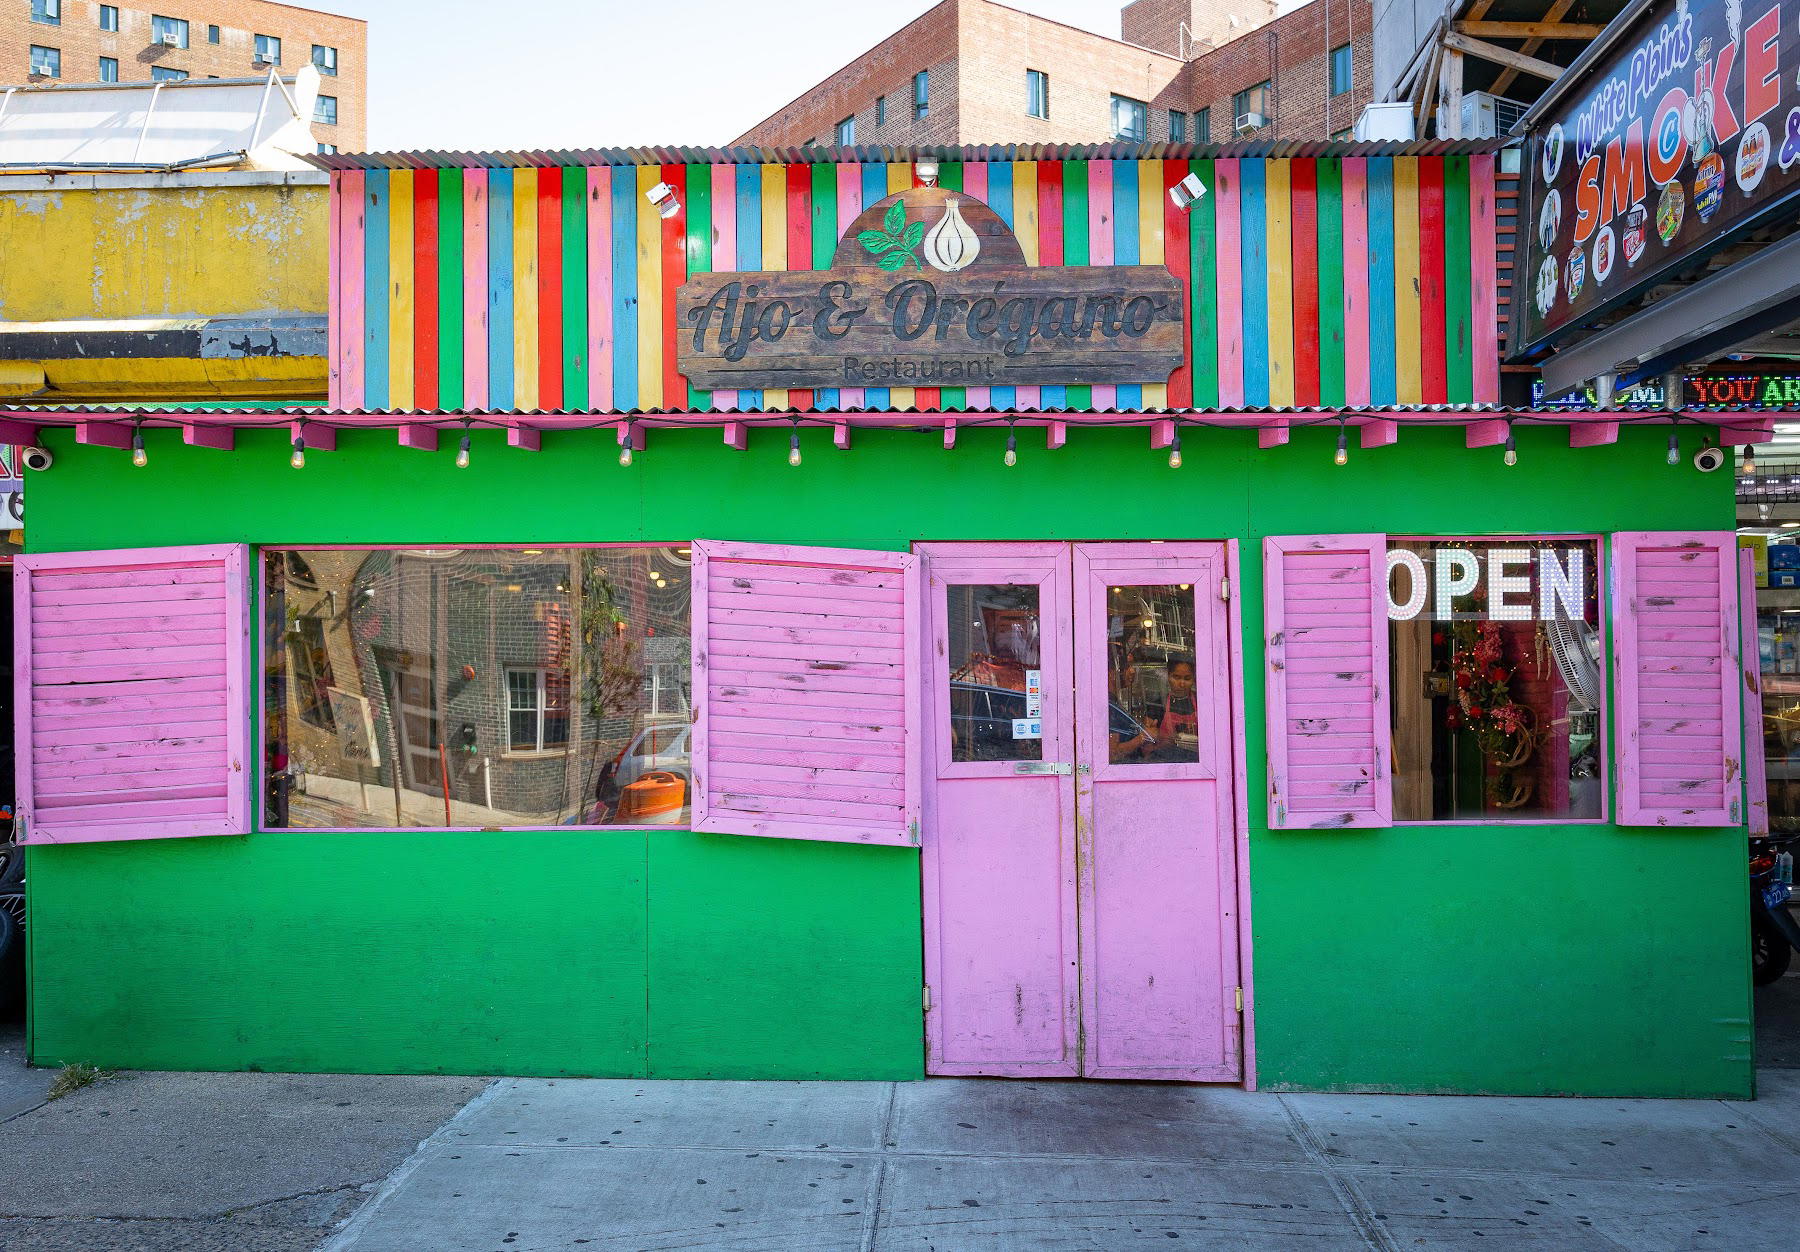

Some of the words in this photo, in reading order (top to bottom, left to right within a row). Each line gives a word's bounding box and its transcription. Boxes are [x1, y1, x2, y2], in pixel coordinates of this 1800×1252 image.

[1574, 3, 1780, 242] SMOKE
[1577, 77, 1626, 165] White
[688, 281, 803, 362] Ajo
[812, 280, 867, 341] &
[885, 279, 1167, 358] Orégano
[844, 356, 994, 380] Restaurant
[1692, 379, 1758, 401] YOU
[1386, 548, 1584, 621] OPEN
